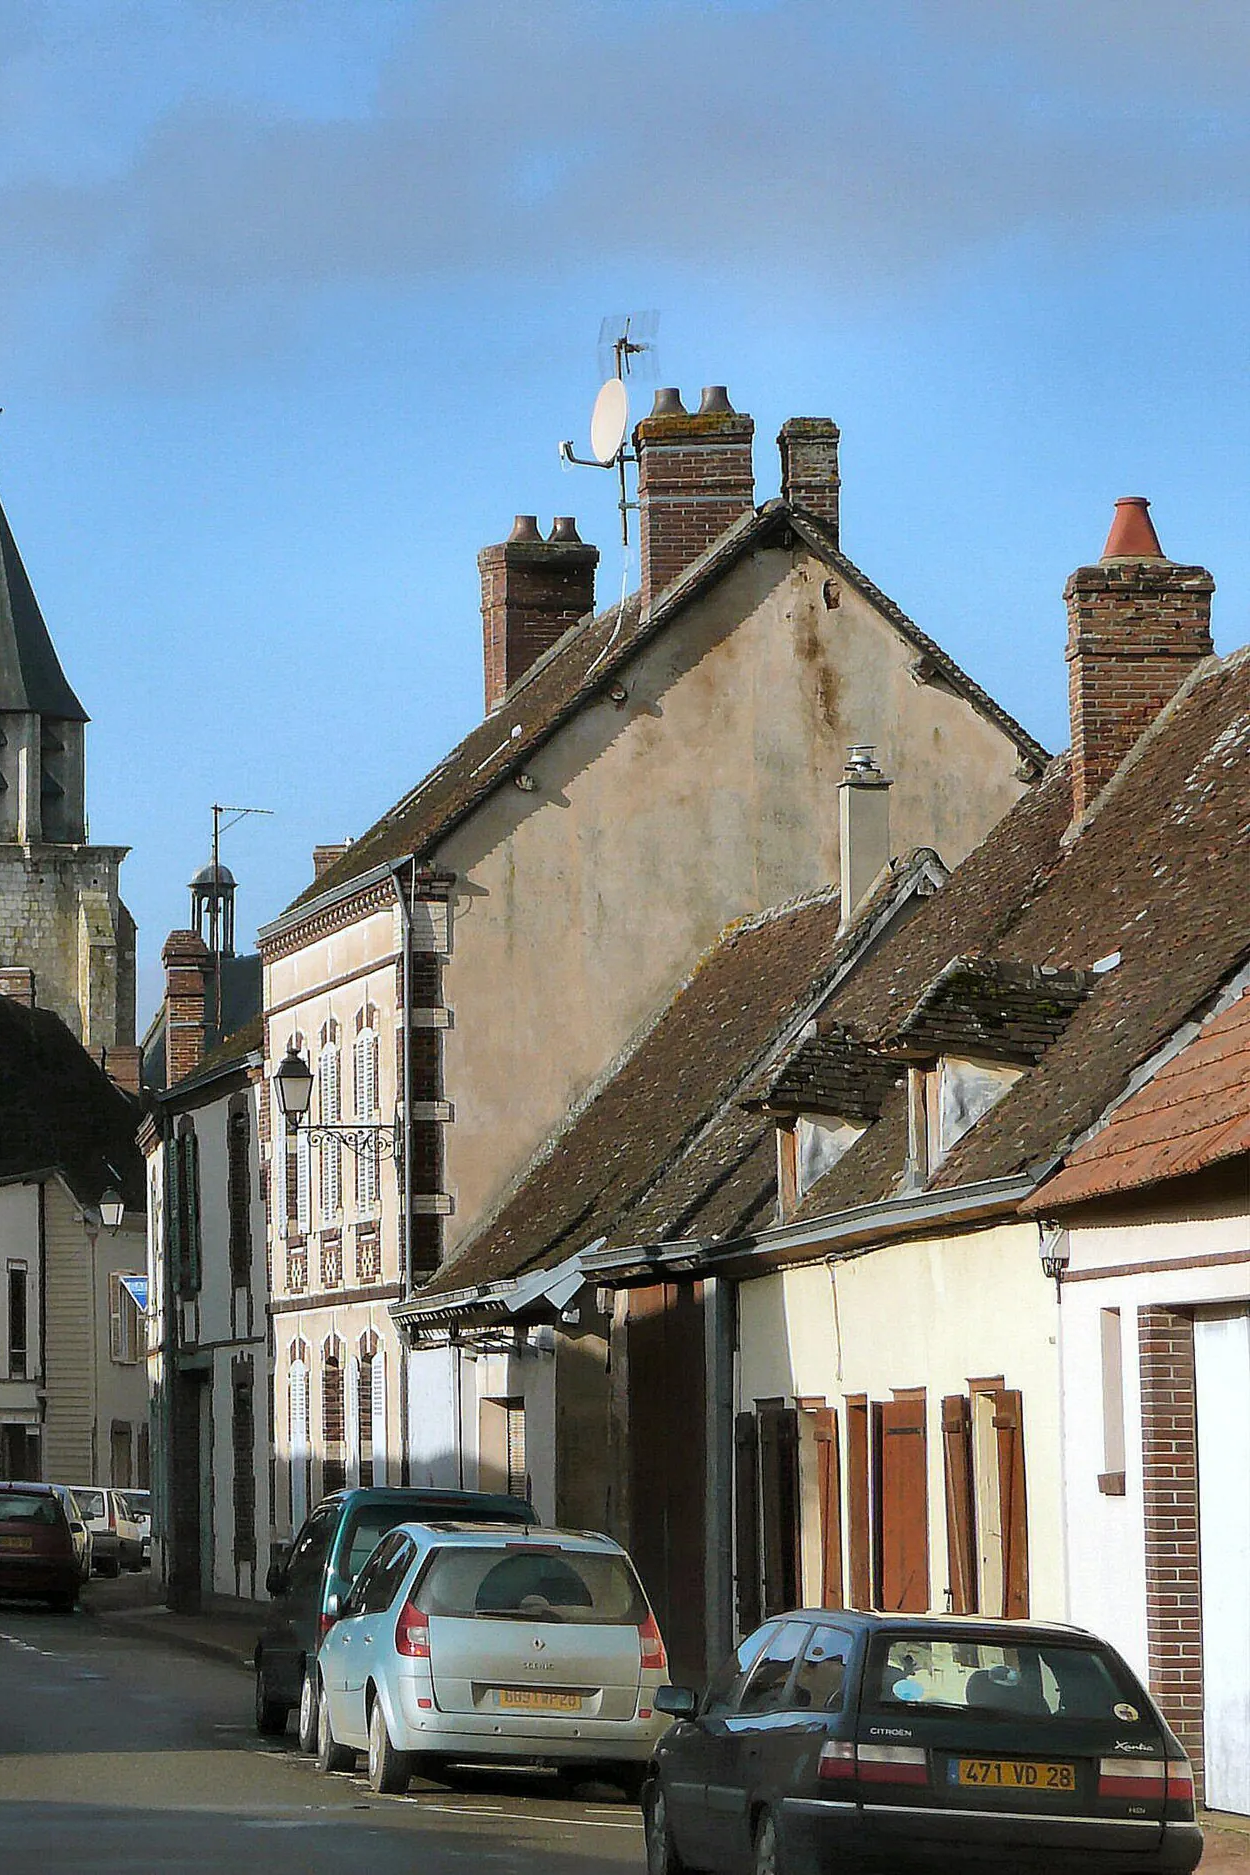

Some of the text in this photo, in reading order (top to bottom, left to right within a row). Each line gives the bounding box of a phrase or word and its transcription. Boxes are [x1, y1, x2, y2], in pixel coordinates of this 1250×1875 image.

[1114, 1740, 1155, 1752] Xantia
[965, 1762, 1071, 1788] 471 VD 28
